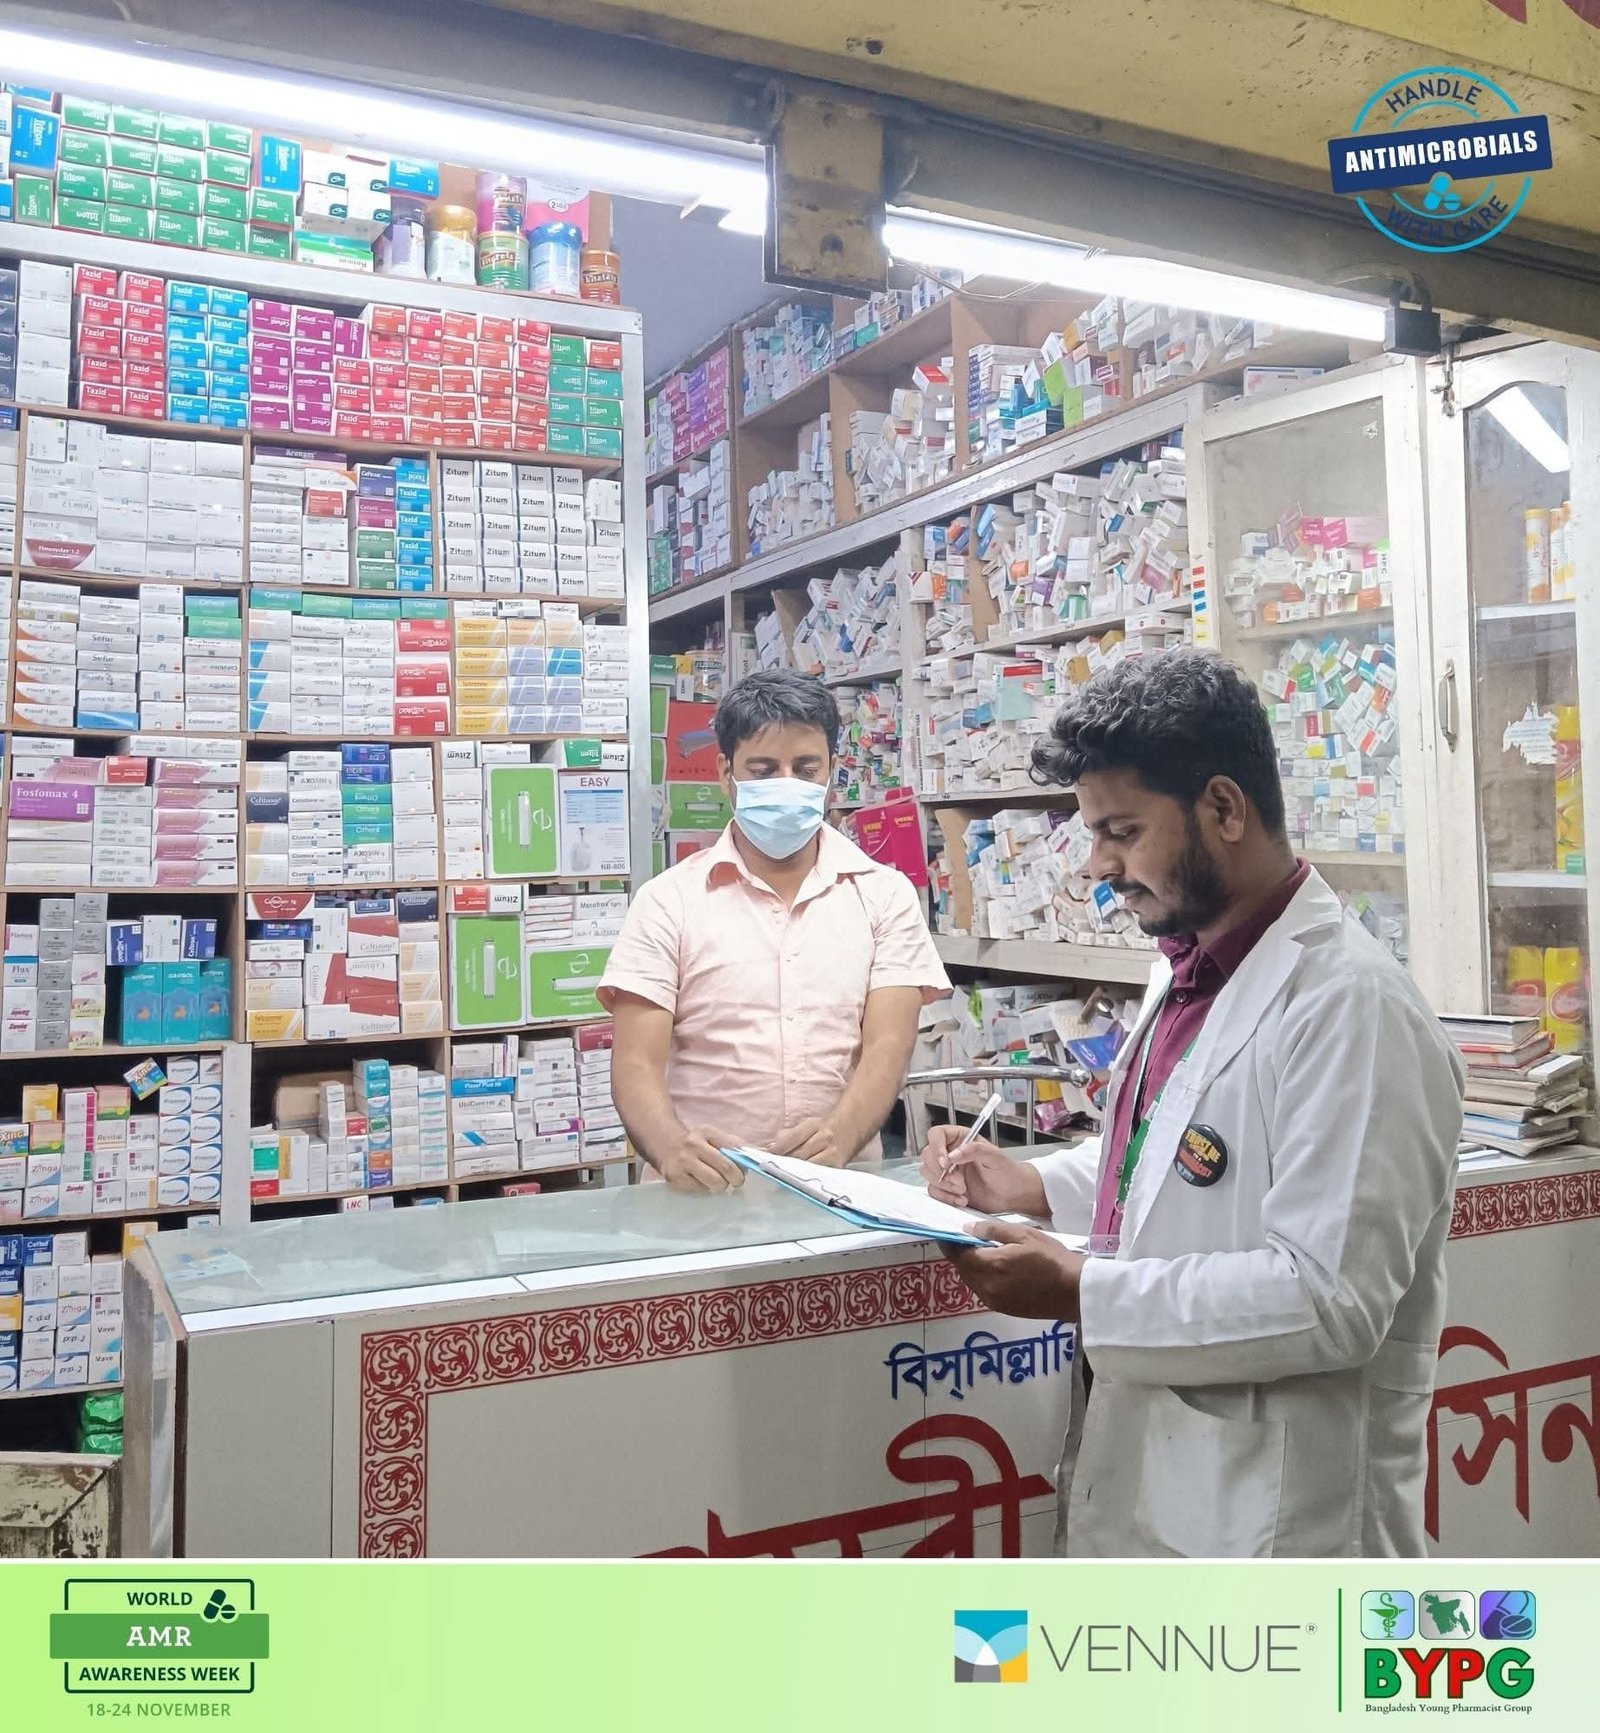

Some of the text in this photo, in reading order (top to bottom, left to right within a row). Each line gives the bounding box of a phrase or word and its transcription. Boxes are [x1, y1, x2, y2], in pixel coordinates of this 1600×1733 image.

[81, 268, 101, 279] Tazid
[129, 276, 149, 287] Tazid
[173, 285, 192, 295] Tazid
[214, 291, 233, 300] Tazid
[88, 298, 108, 310] Tazid
[129, 304, 150, 316] Tazid
[213, 319, 232, 328] Tazid
[84, 327, 104, 338] Tazid
[129, 333, 150, 344] Tazid
[215, 345, 234, 355] Tazid
[86, 357, 107, 368] Tazid
[129, 363, 150, 374] Tazid
[215, 374, 234, 384] Tazid
[86, 385, 107, 396] Tazid
[129, 391, 149, 401] Tazid
[174, 398, 193, 407] Tazid
[446, 468, 469, 477] Zitum
[485, 468, 508, 477] Zitum
[408, 474, 426, 482] Tazid
[521, 473, 544, 482] Zitum
[557, 475, 579, 484] Zitum
[400, 489, 417, 498] Tazid
[447, 494, 470, 502] Zitum
[485, 496, 508, 504] Zitum
[522, 498, 545, 506] Zitum
[558, 501, 581, 511] Zitum
[400, 516, 418, 524] Tazid
[448, 520, 471, 529] Zitum
[487, 521, 510, 531] Zitum
[523, 523, 546, 532] Zitum
[560, 526, 582, 535] Zitum
[599, 528, 620, 538] Zitum
[401, 541, 418, 549] Tazid
[449, 547, 473, 556] Zitum
[487, 547, 510, 556] Zitum
[523, 550, 546, 558] Zitum
[560, 553, 582, 562] Zitum
[401, 569, 418, 577] Tazid
[450, 573, 473, 582] Zitum
[488, 574, 511, 583] Zitum
[525, 575, 548, 584] Zitum
[561, 577, 584, 586] Zitum
[580, 777, 610, 787] EASY
[16, 788, 79, 799] Fosfomax 4
[494, 895, 518, 903] Zitum
